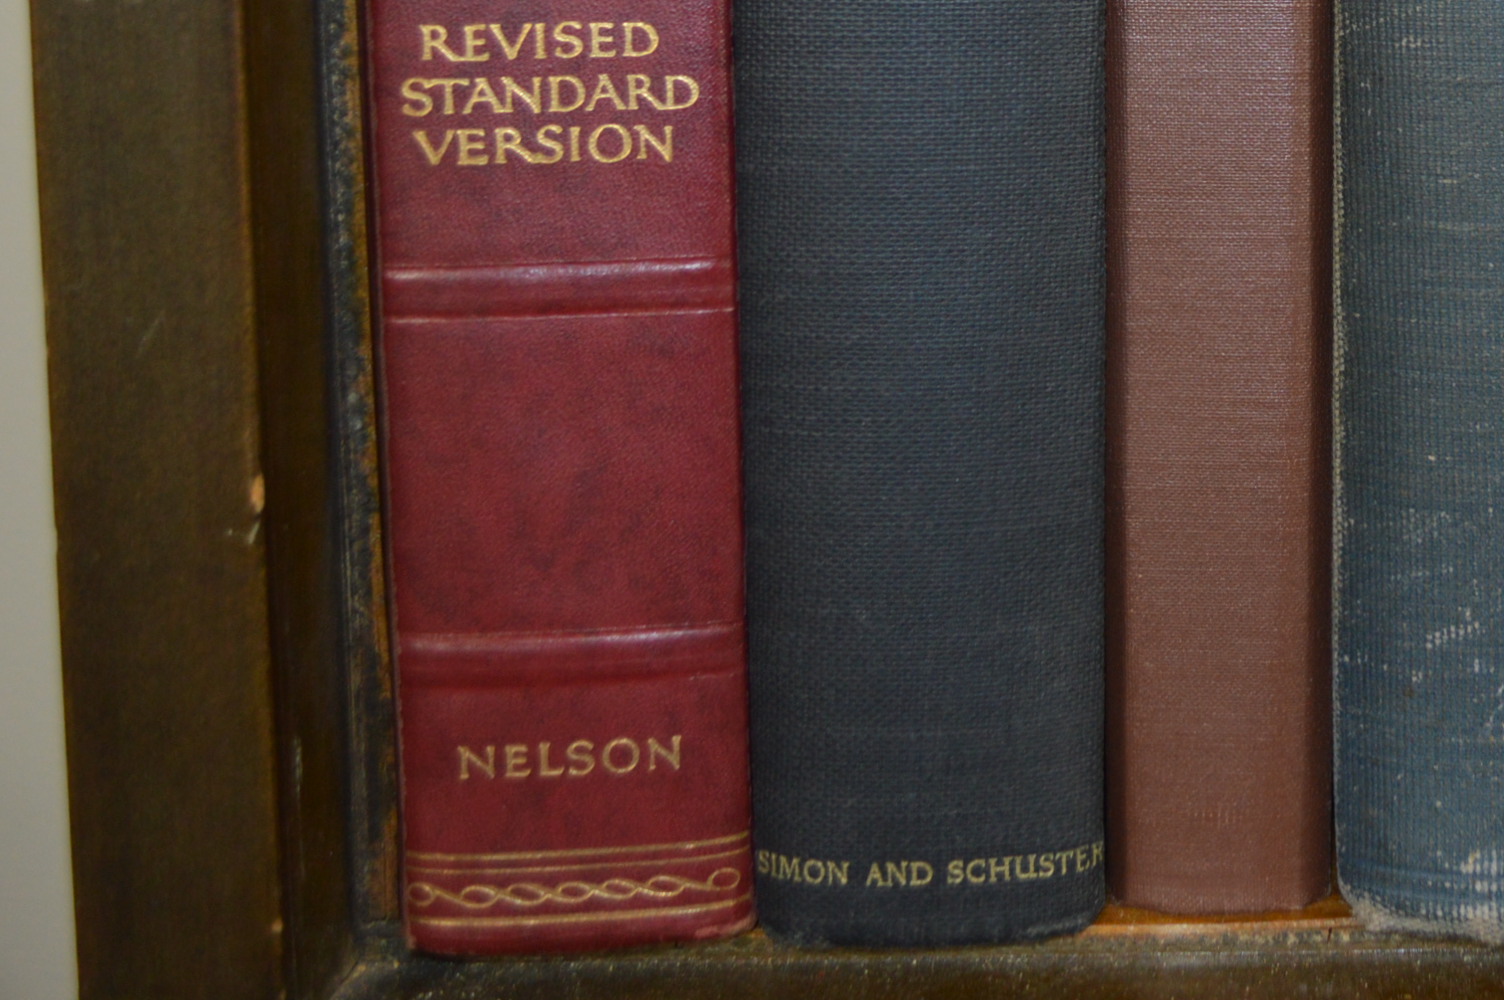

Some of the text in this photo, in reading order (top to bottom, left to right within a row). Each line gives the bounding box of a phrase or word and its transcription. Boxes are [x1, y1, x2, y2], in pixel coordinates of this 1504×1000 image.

[418, 21, 659, 62] REVISED
[401, 74, 700, 117] STANDARD
[412, 123, 674, 165] VERSION
[457, 735, 683, 781] NELSON
[757, 841, 1103, 887] SIMON AND SCHUSTER
